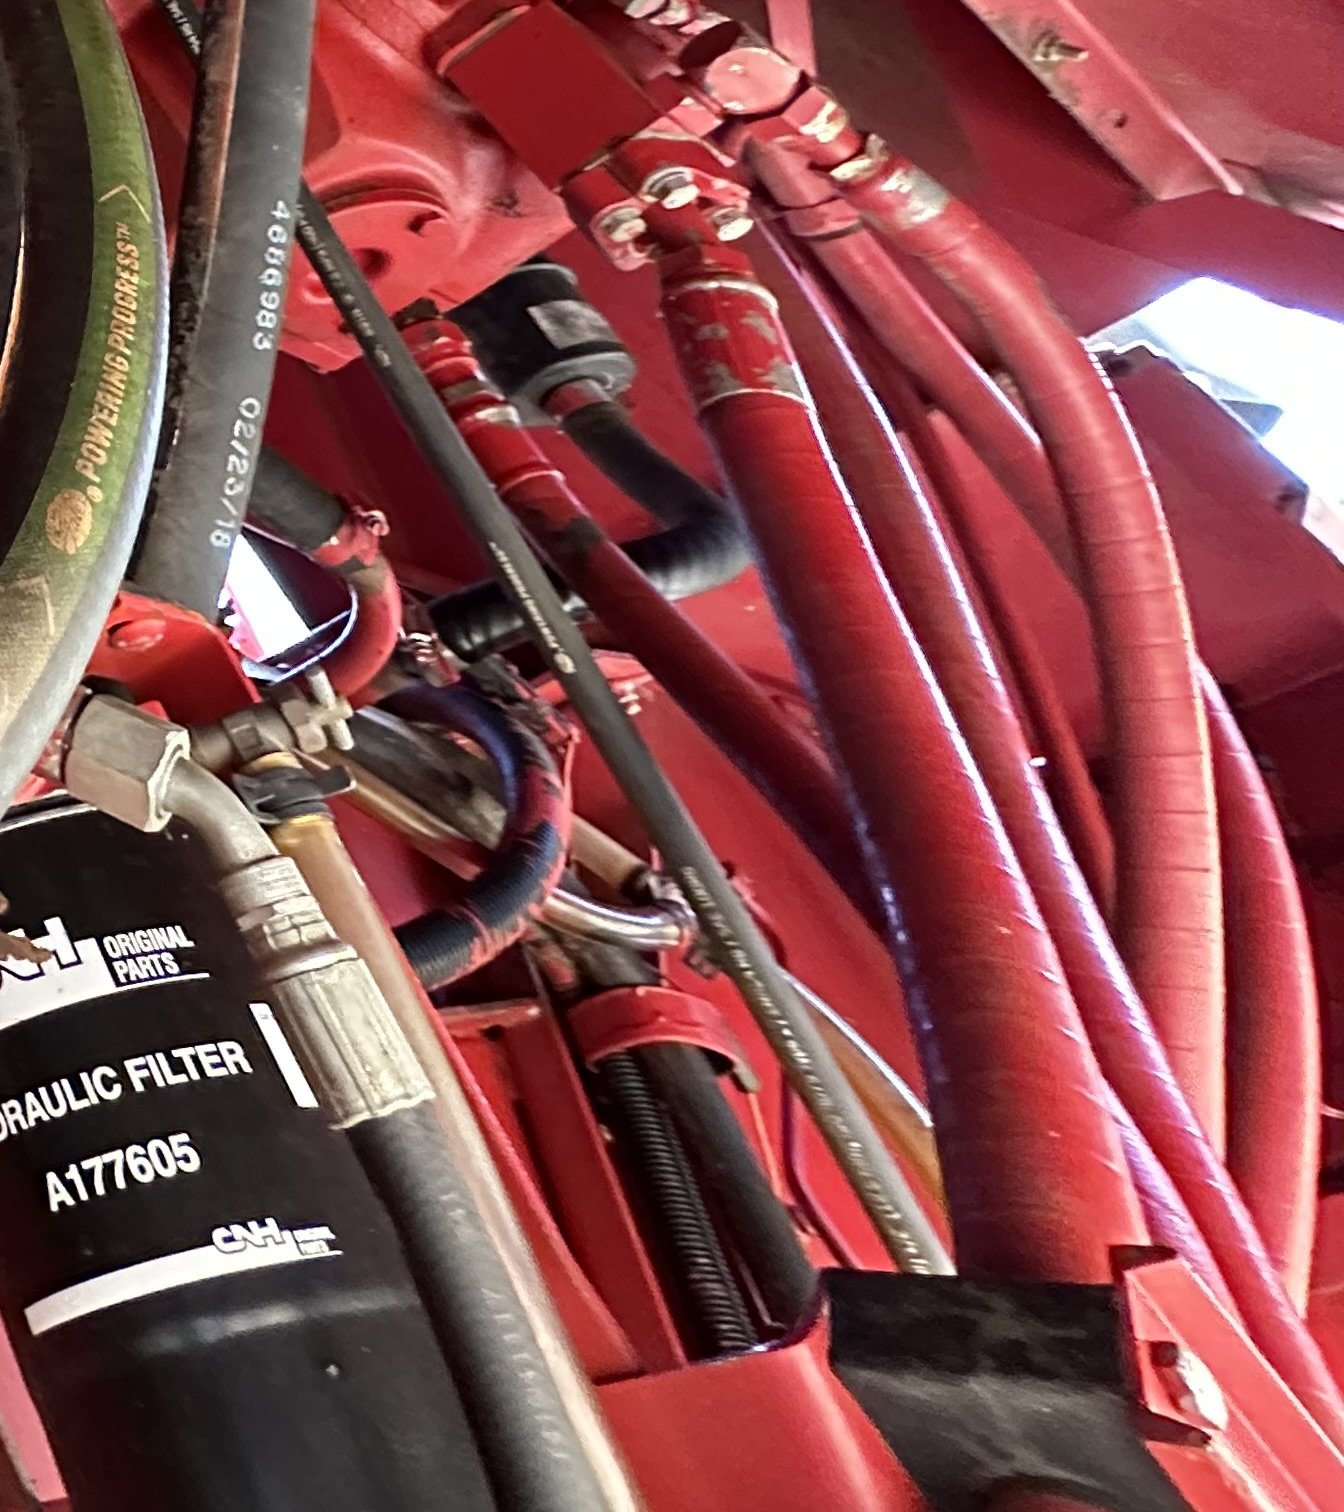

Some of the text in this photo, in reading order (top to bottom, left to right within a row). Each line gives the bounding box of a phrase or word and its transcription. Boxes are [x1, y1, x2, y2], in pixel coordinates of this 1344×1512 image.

[75, 348, 130, 484] POWERING
[102, 924, 195, 959] ORIGINAL
[112, 952, 180, 984] PARTS
[132, 1038, 254, 1096] FILTER
[44, 1131, 203, 1216] A177605
[211, 1216, 286, 1255] CNH
